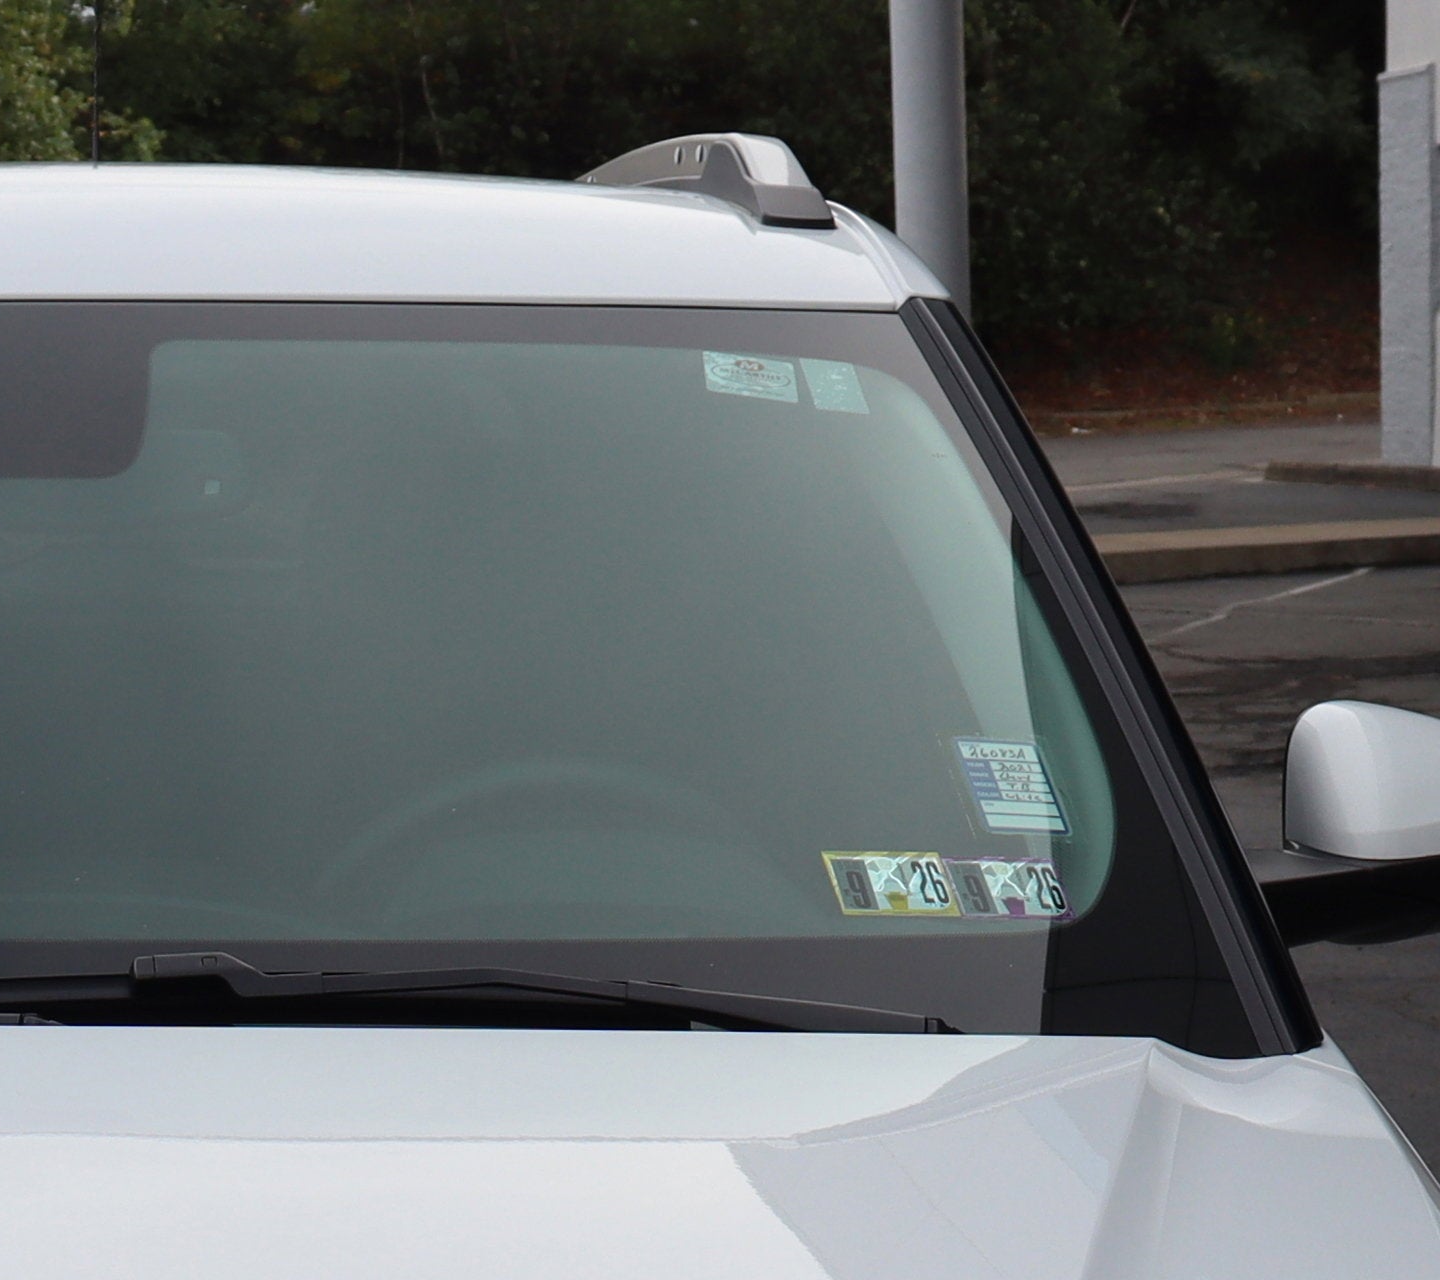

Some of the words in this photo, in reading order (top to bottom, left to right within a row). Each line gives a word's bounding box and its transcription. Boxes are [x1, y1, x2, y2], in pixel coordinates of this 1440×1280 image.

[969, 747, 1026, 760] 26083A
[846, 871, 872, 908] 9
[911, 861, 950, 904] 26
[964, 874, 991, 912] 9
[1027, 866, 1066, 910] 26
